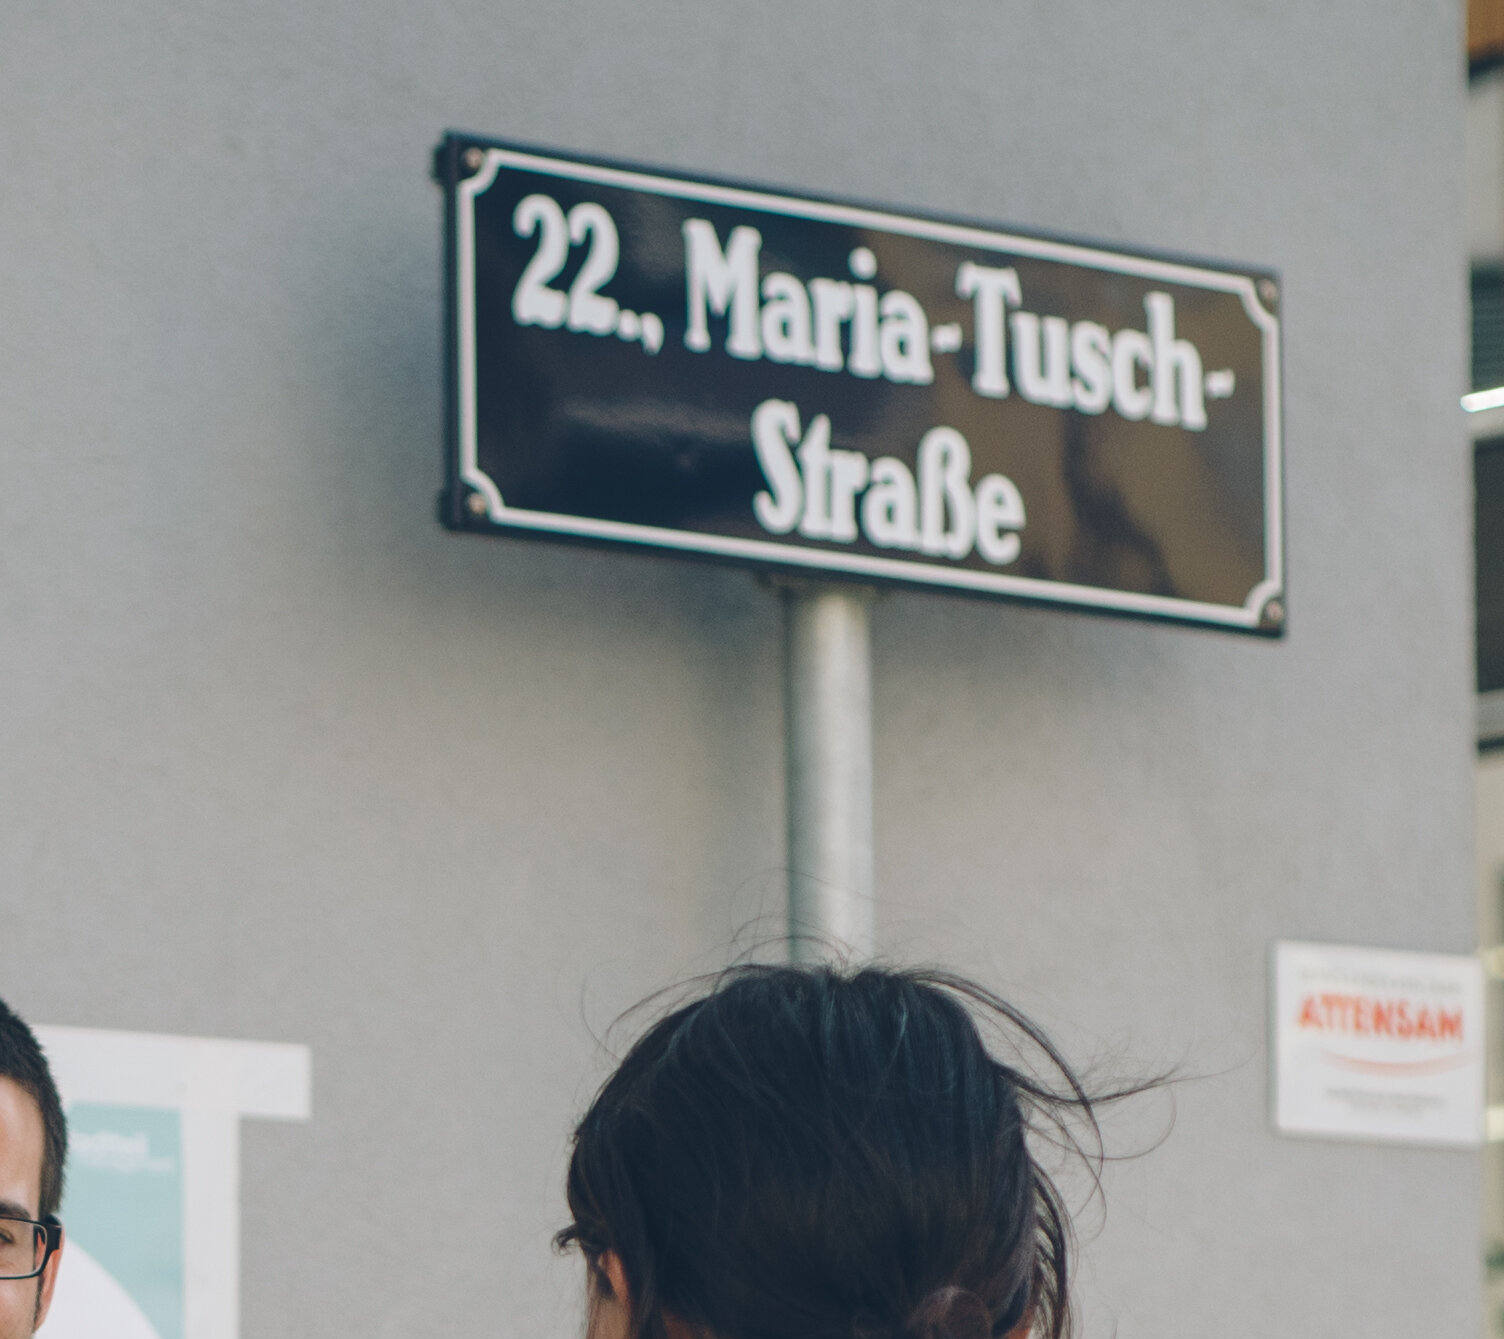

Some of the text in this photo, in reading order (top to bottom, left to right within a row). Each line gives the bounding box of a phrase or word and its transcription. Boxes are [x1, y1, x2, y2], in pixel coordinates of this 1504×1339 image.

[511, 192, 1235, 430] 22., Maria-Tusch-
[749, 398, 1026, 564] Straße
[1297, 993, 1463, 1042] ATTENSAM
